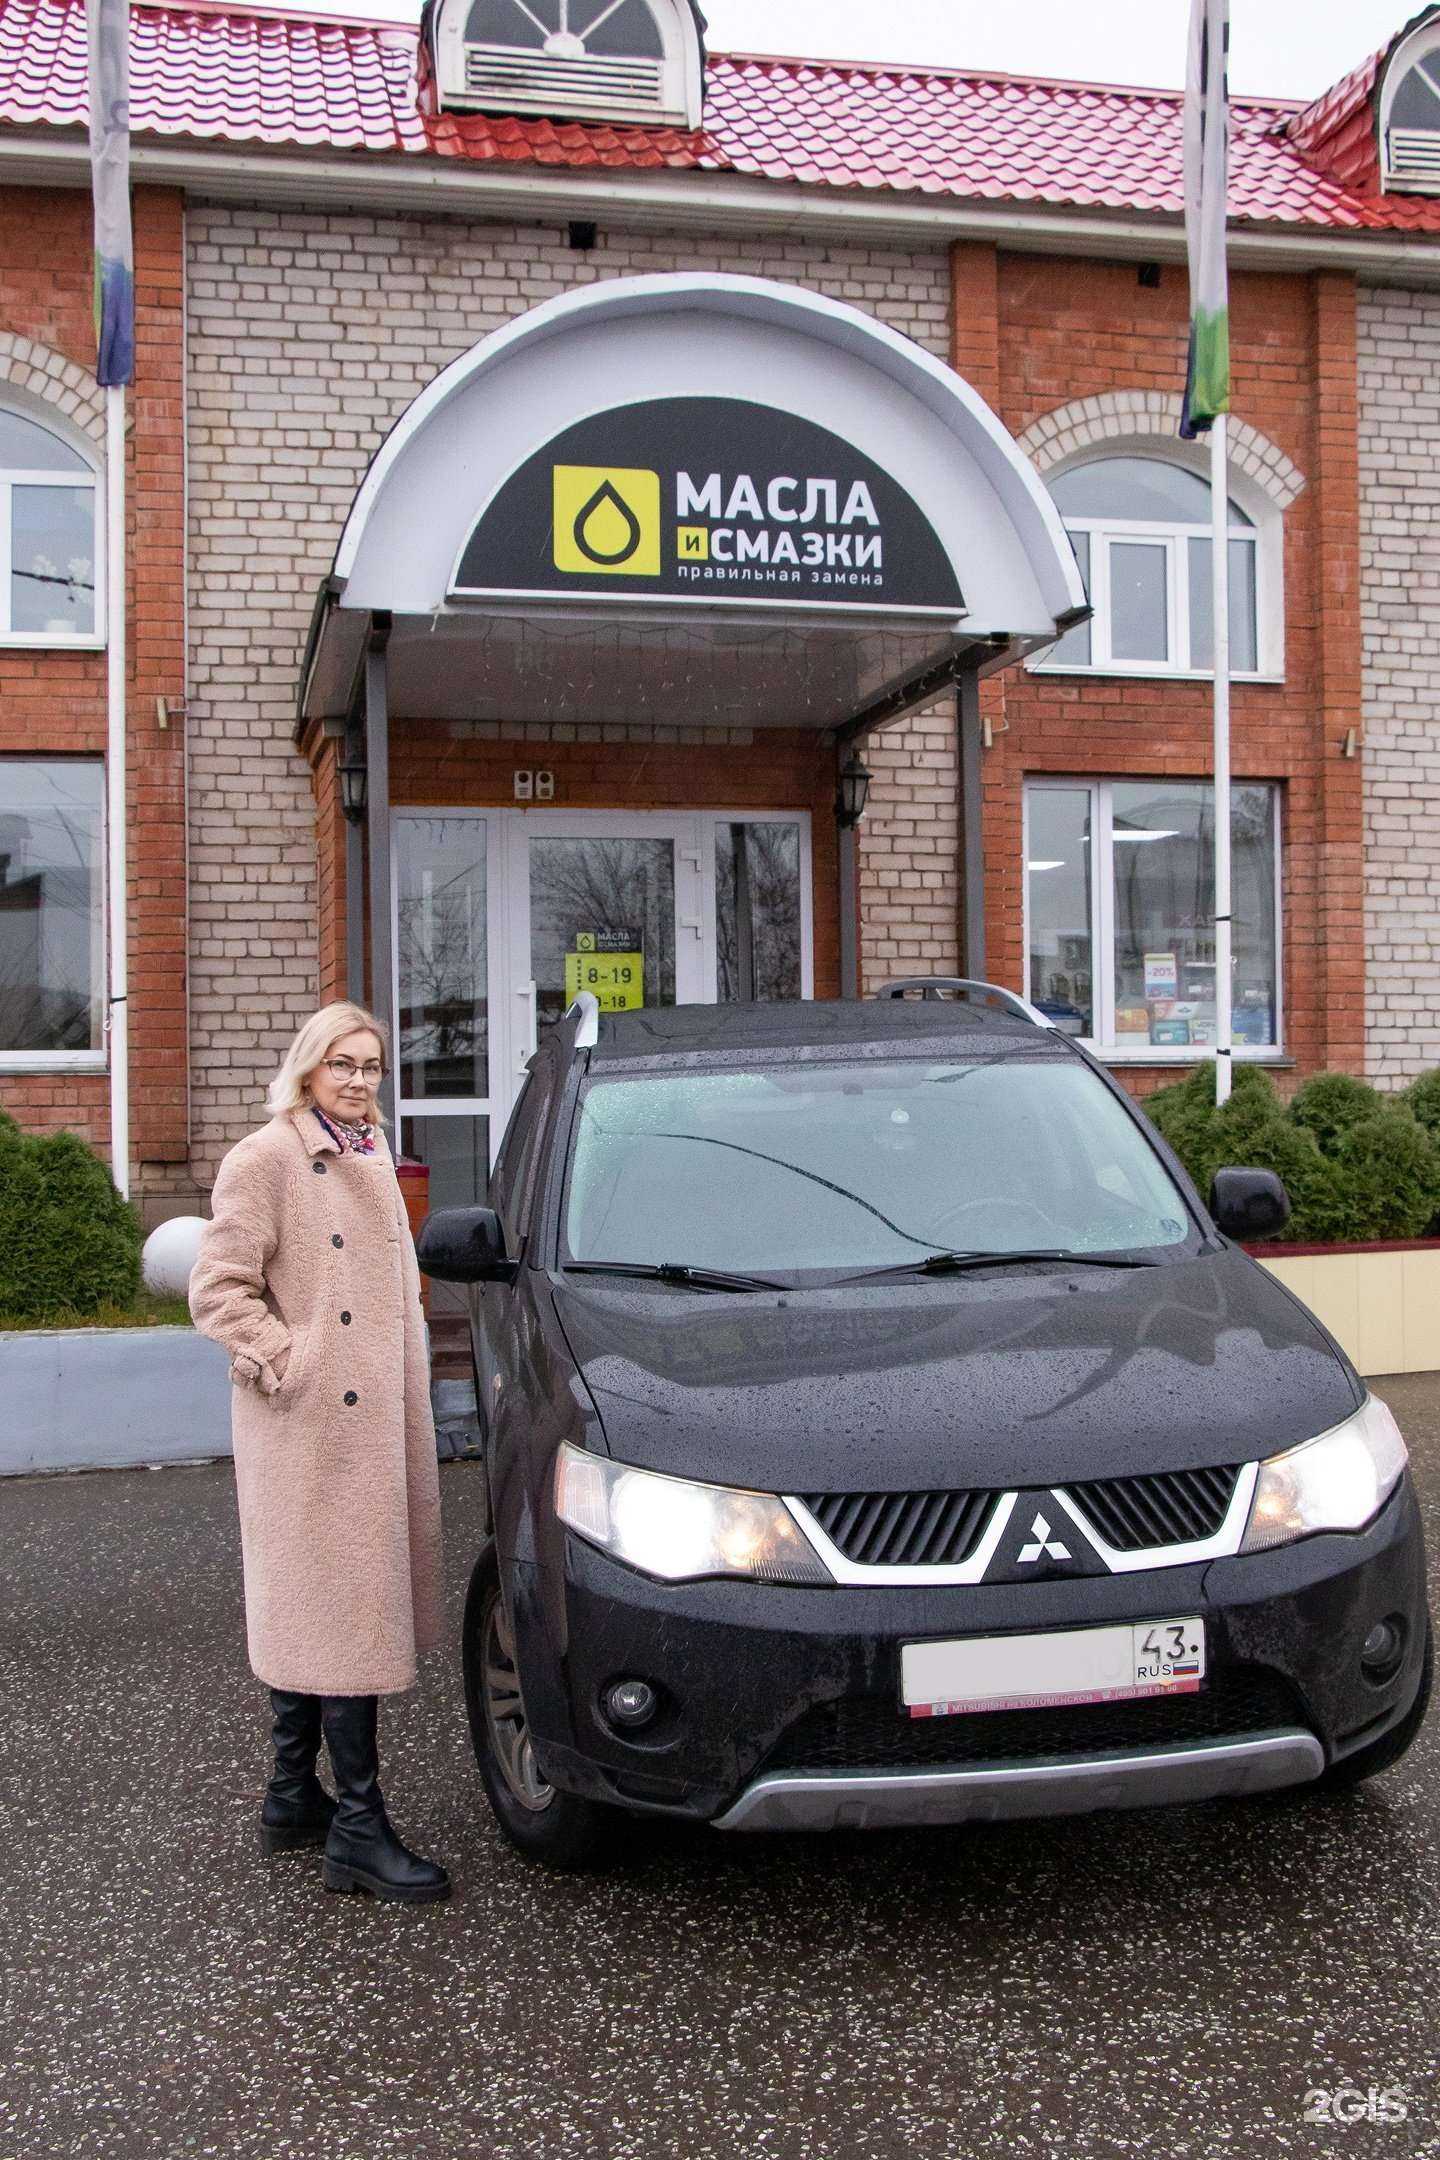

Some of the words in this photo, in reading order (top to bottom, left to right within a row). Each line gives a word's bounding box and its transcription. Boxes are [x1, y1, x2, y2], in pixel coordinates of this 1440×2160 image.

[676, 472, 880, 526] МАСЛА
[711, 528, 883, 569] СМАЗКИ
[678, 565, 801, 583] правильная
[811, 572, 884, 586] замена
[597, 932, 630, 941] МАСЛА
[1141, 1625, 1185, 1664] 43
[1137, 1663, 1172, 1678] RUS
